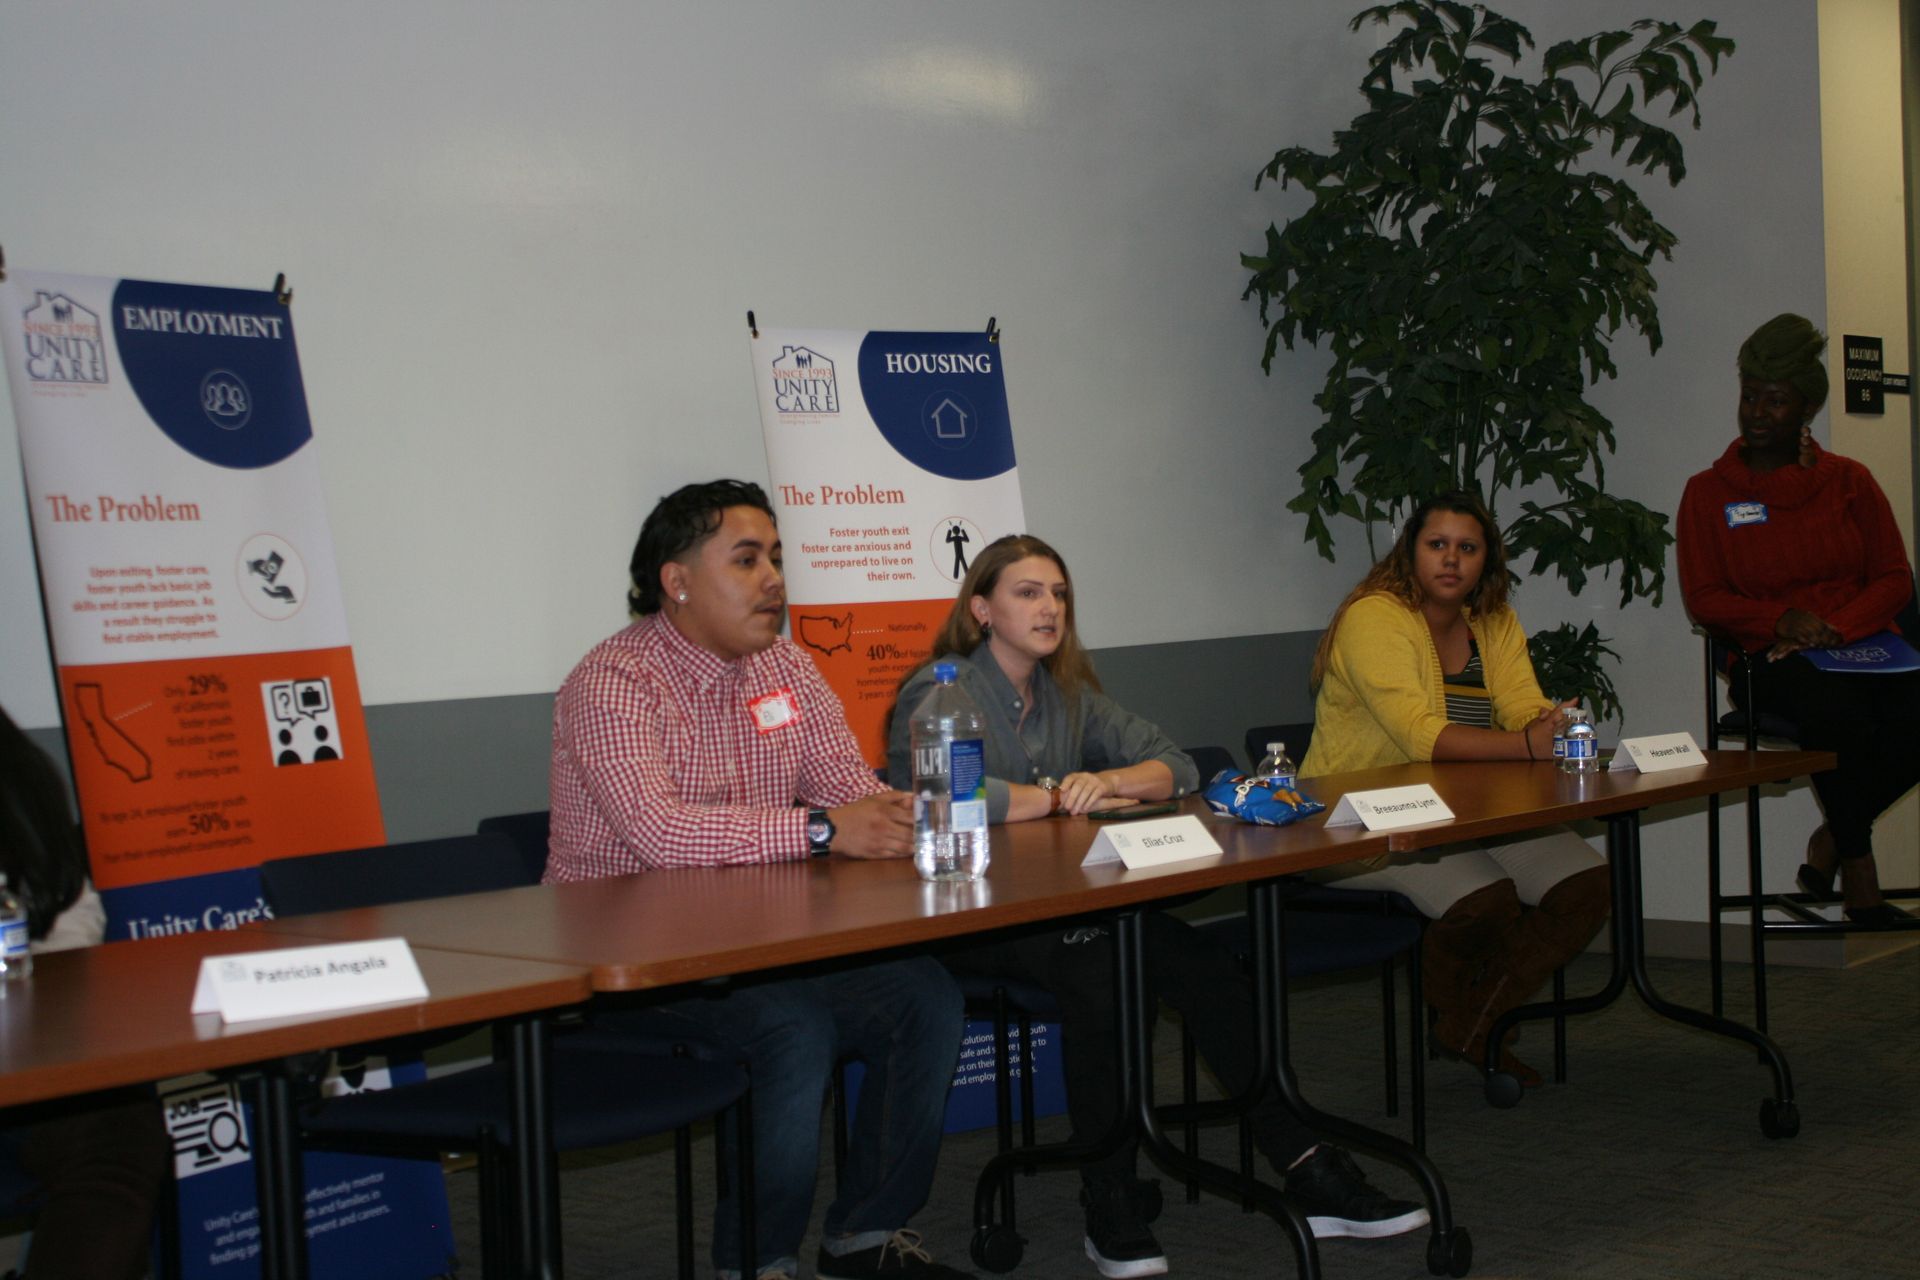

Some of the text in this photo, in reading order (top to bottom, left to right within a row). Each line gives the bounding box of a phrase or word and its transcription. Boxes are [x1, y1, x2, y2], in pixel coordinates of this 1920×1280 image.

[121, 305, 284, 340] EMPLOYMENT
[24, 334, 99, 361] UNITY
[26, 358, 101, 381] CARE
[807, 368, 833, 379] 1993
[885, 353, 992, 375] HOUSING
[774, 378, 834, 397] UNITY
[776, 395, 836, 412] CARE
[778, 483, 906, 506] The Problem
[47, 494, 201, 523] The Problem
[829, 526, 910, 539] Foster youth exit
[801, 540, 912, 554] foster care anxious and
[811, 556, 914, 571] unprepared to live on
[867, 570, 917, 582] their own.
[866, 642, 900, 661] 40%
[188, 673, 228, 696] 29%
[1649, 744, 1690, 758] Heaven Wall
[1373, 798, 1437, 815] Breeaunna Lynn
[188, 811, 231, 836] 50%
[1142, 833, 1186, 849] Elias Cruz
[127, 897, 275, 941] Unity Care's
[253, 955, 388, 985] Patricia Angala
[960, 1050, 976, 1060] safe
[976, 1046, 991, 1056] and
[1037, 1038, 1047, 1047] to
[966, 1062, 977, 1070] on
[977, 1058, 996, 1069] their
[952, 1075, 967, 1087] and
[169, 1097, 201, 1121] JOB
